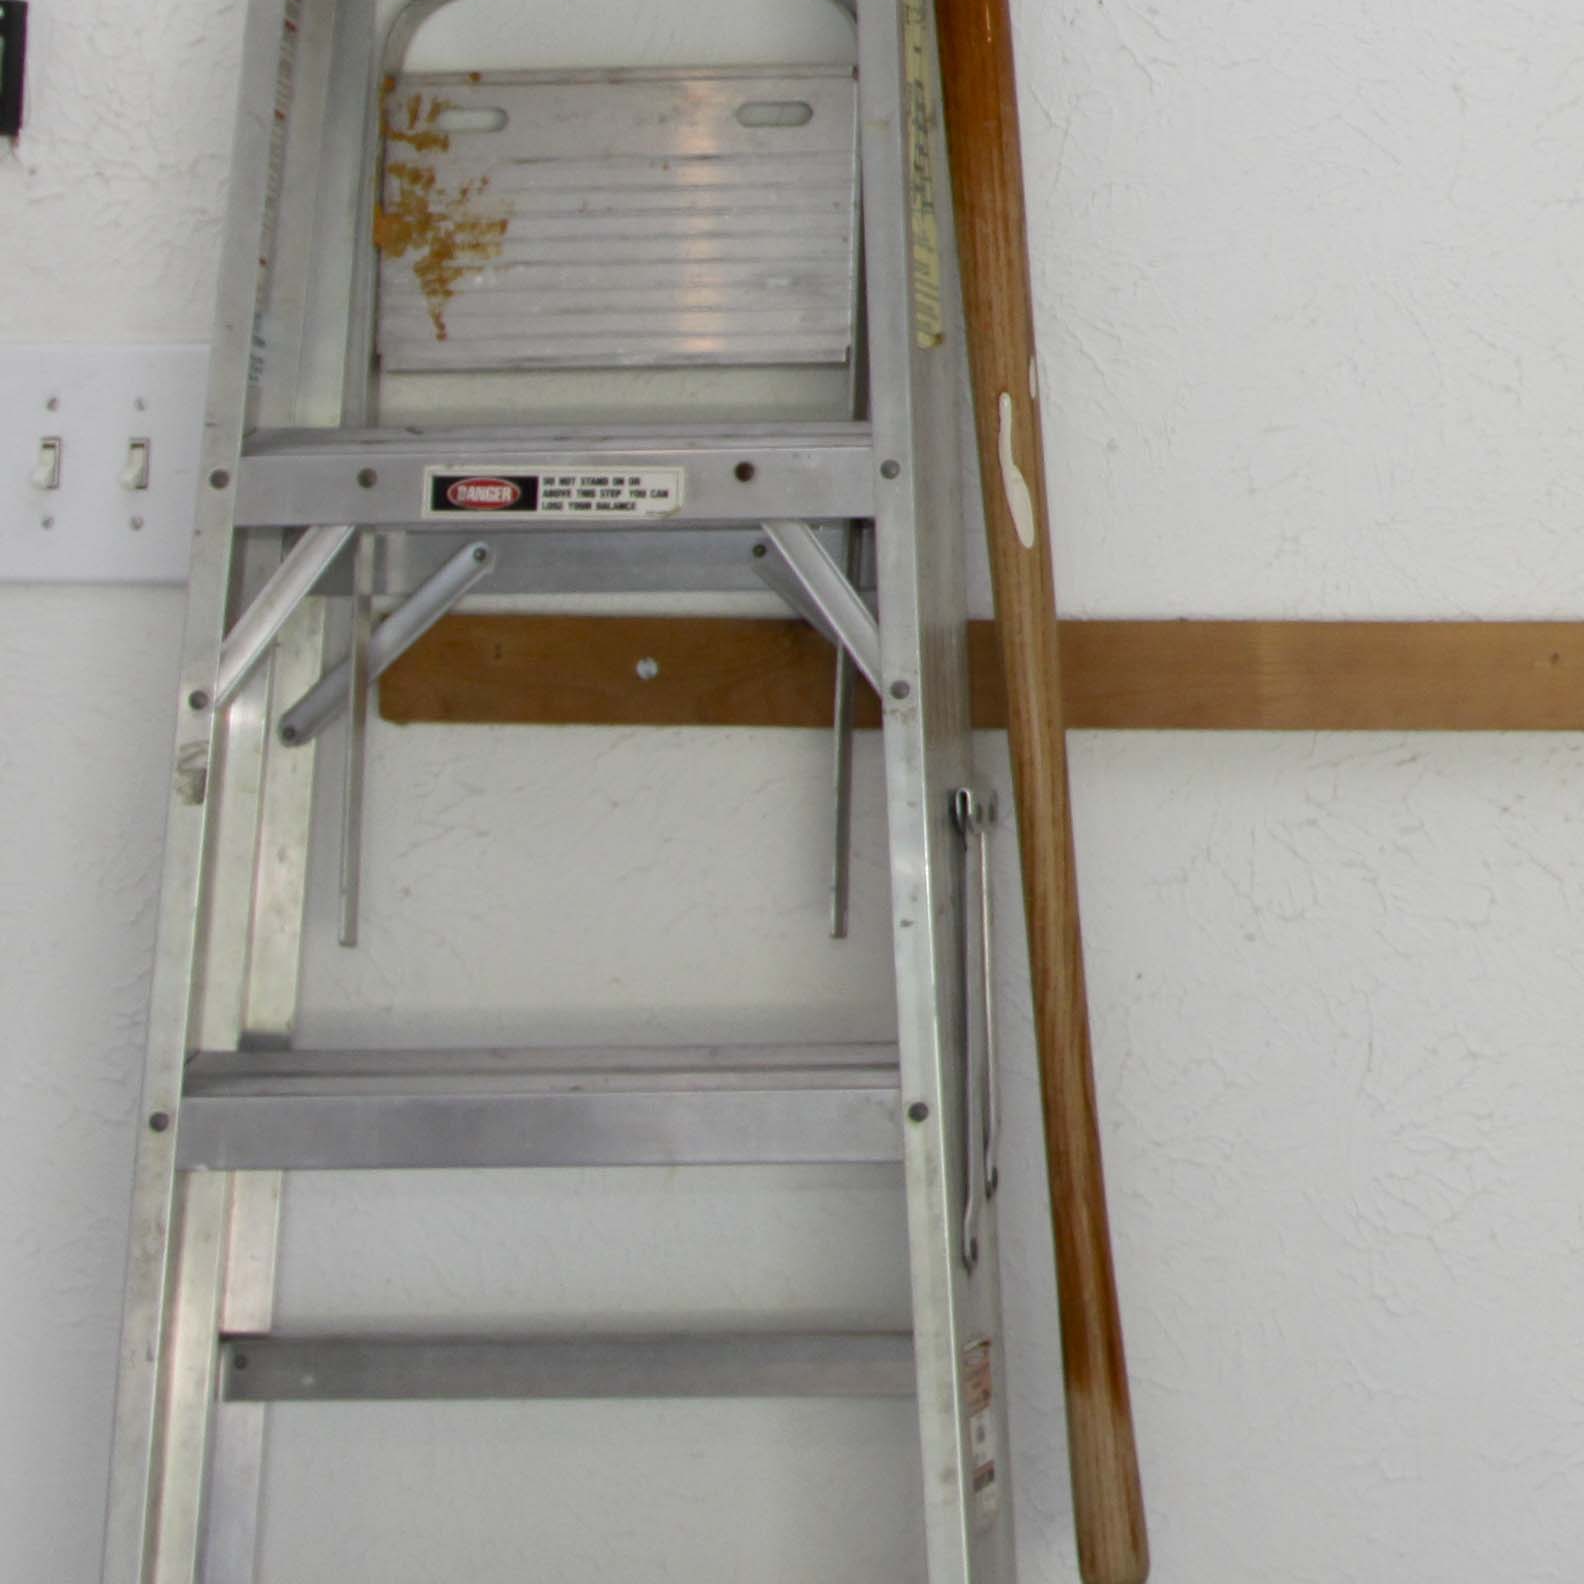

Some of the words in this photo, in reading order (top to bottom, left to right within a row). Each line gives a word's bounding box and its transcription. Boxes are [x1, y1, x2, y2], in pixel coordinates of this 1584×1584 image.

[543, 477, 555, 486] DO
[559, 477, 576, 486] NOT
[581, 477, 609, 486] STAND
[457, 485, 512, 503] DANGER
[542, 489, 571, 498] ABOVE
[577, 489, 596, 498] THIS
[629, 489, 647, 498] YOU
[650, 489, 669, 498] CAN
[541, 501, 563, 511] LOSE
[568, 501, 592, 511] YOUR
